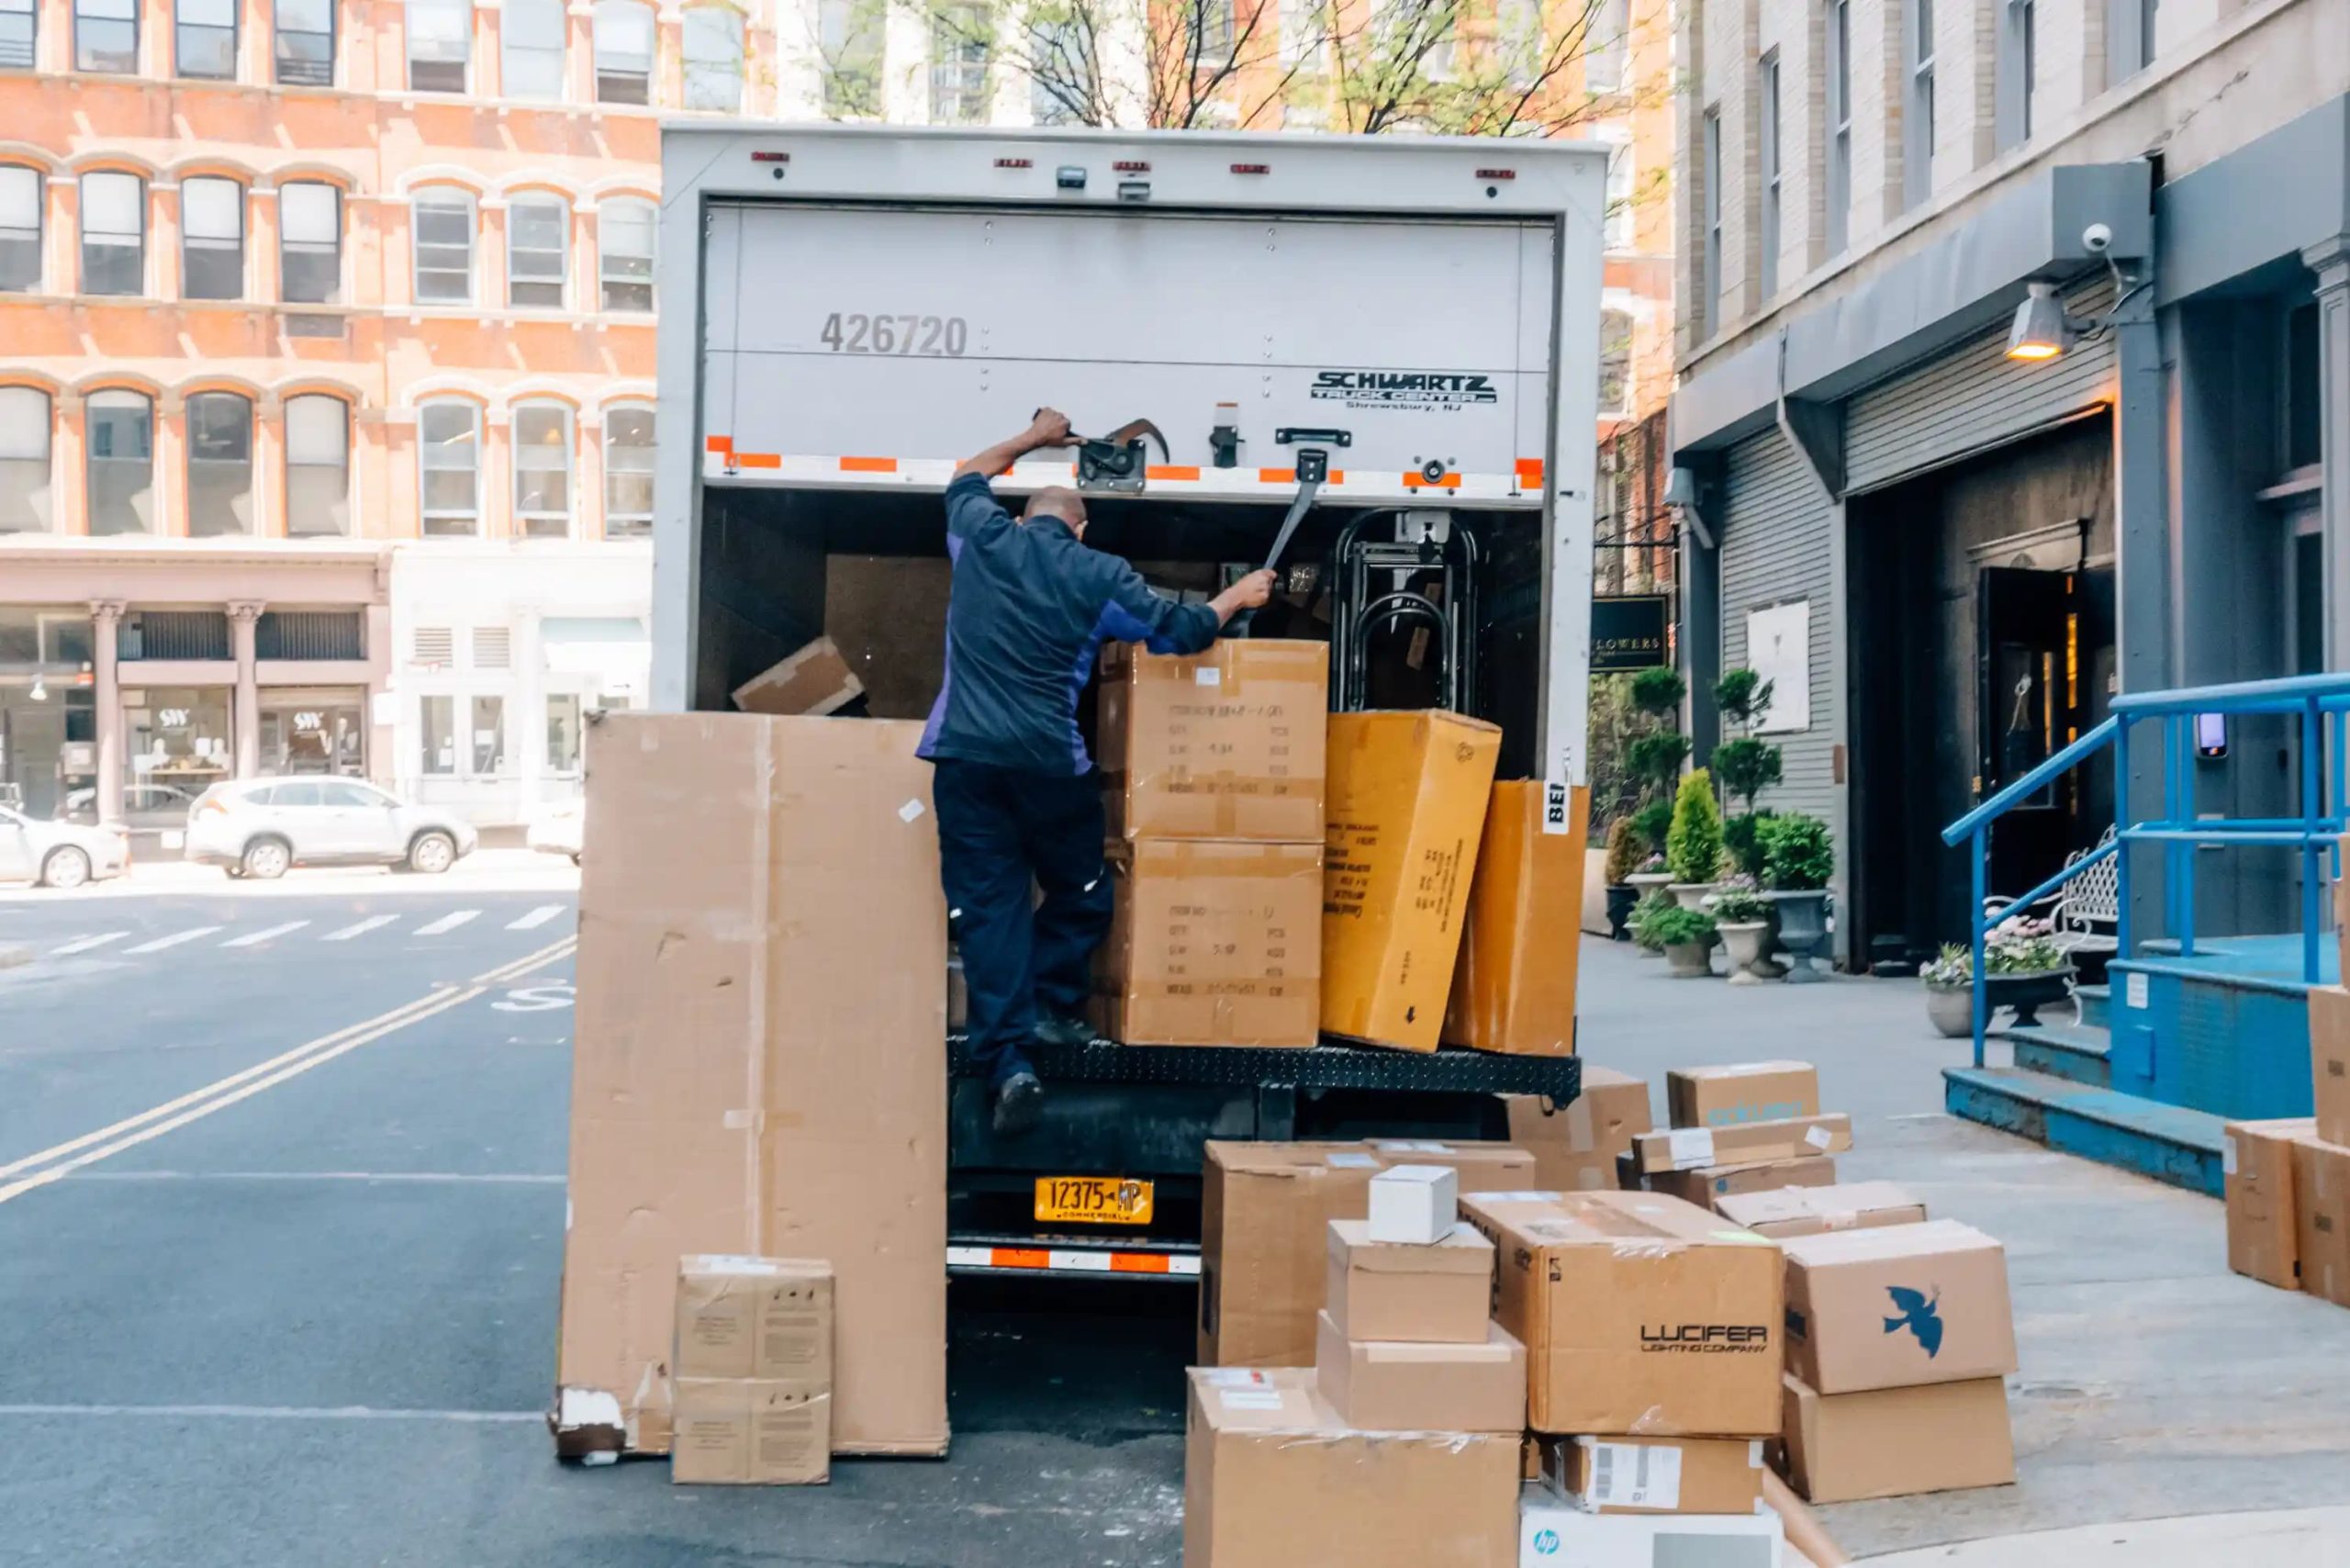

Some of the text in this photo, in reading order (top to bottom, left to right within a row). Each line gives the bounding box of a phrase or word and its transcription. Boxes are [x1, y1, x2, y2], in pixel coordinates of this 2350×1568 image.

[820, 312, 968, 356] 426720
[1311, 372, 1496, 392] SCHWARTZ
[1312, 390, 1476, 402] TRUCK CENTER
[1595, 638, 1660, 650] LOWERS
[1051, 1182, 1104, 1209] 12375
[1640, 1325, 1767, 1341] LUCIFER
[1641, 1344, 1767, 1353] LIGHTING COMPANY
